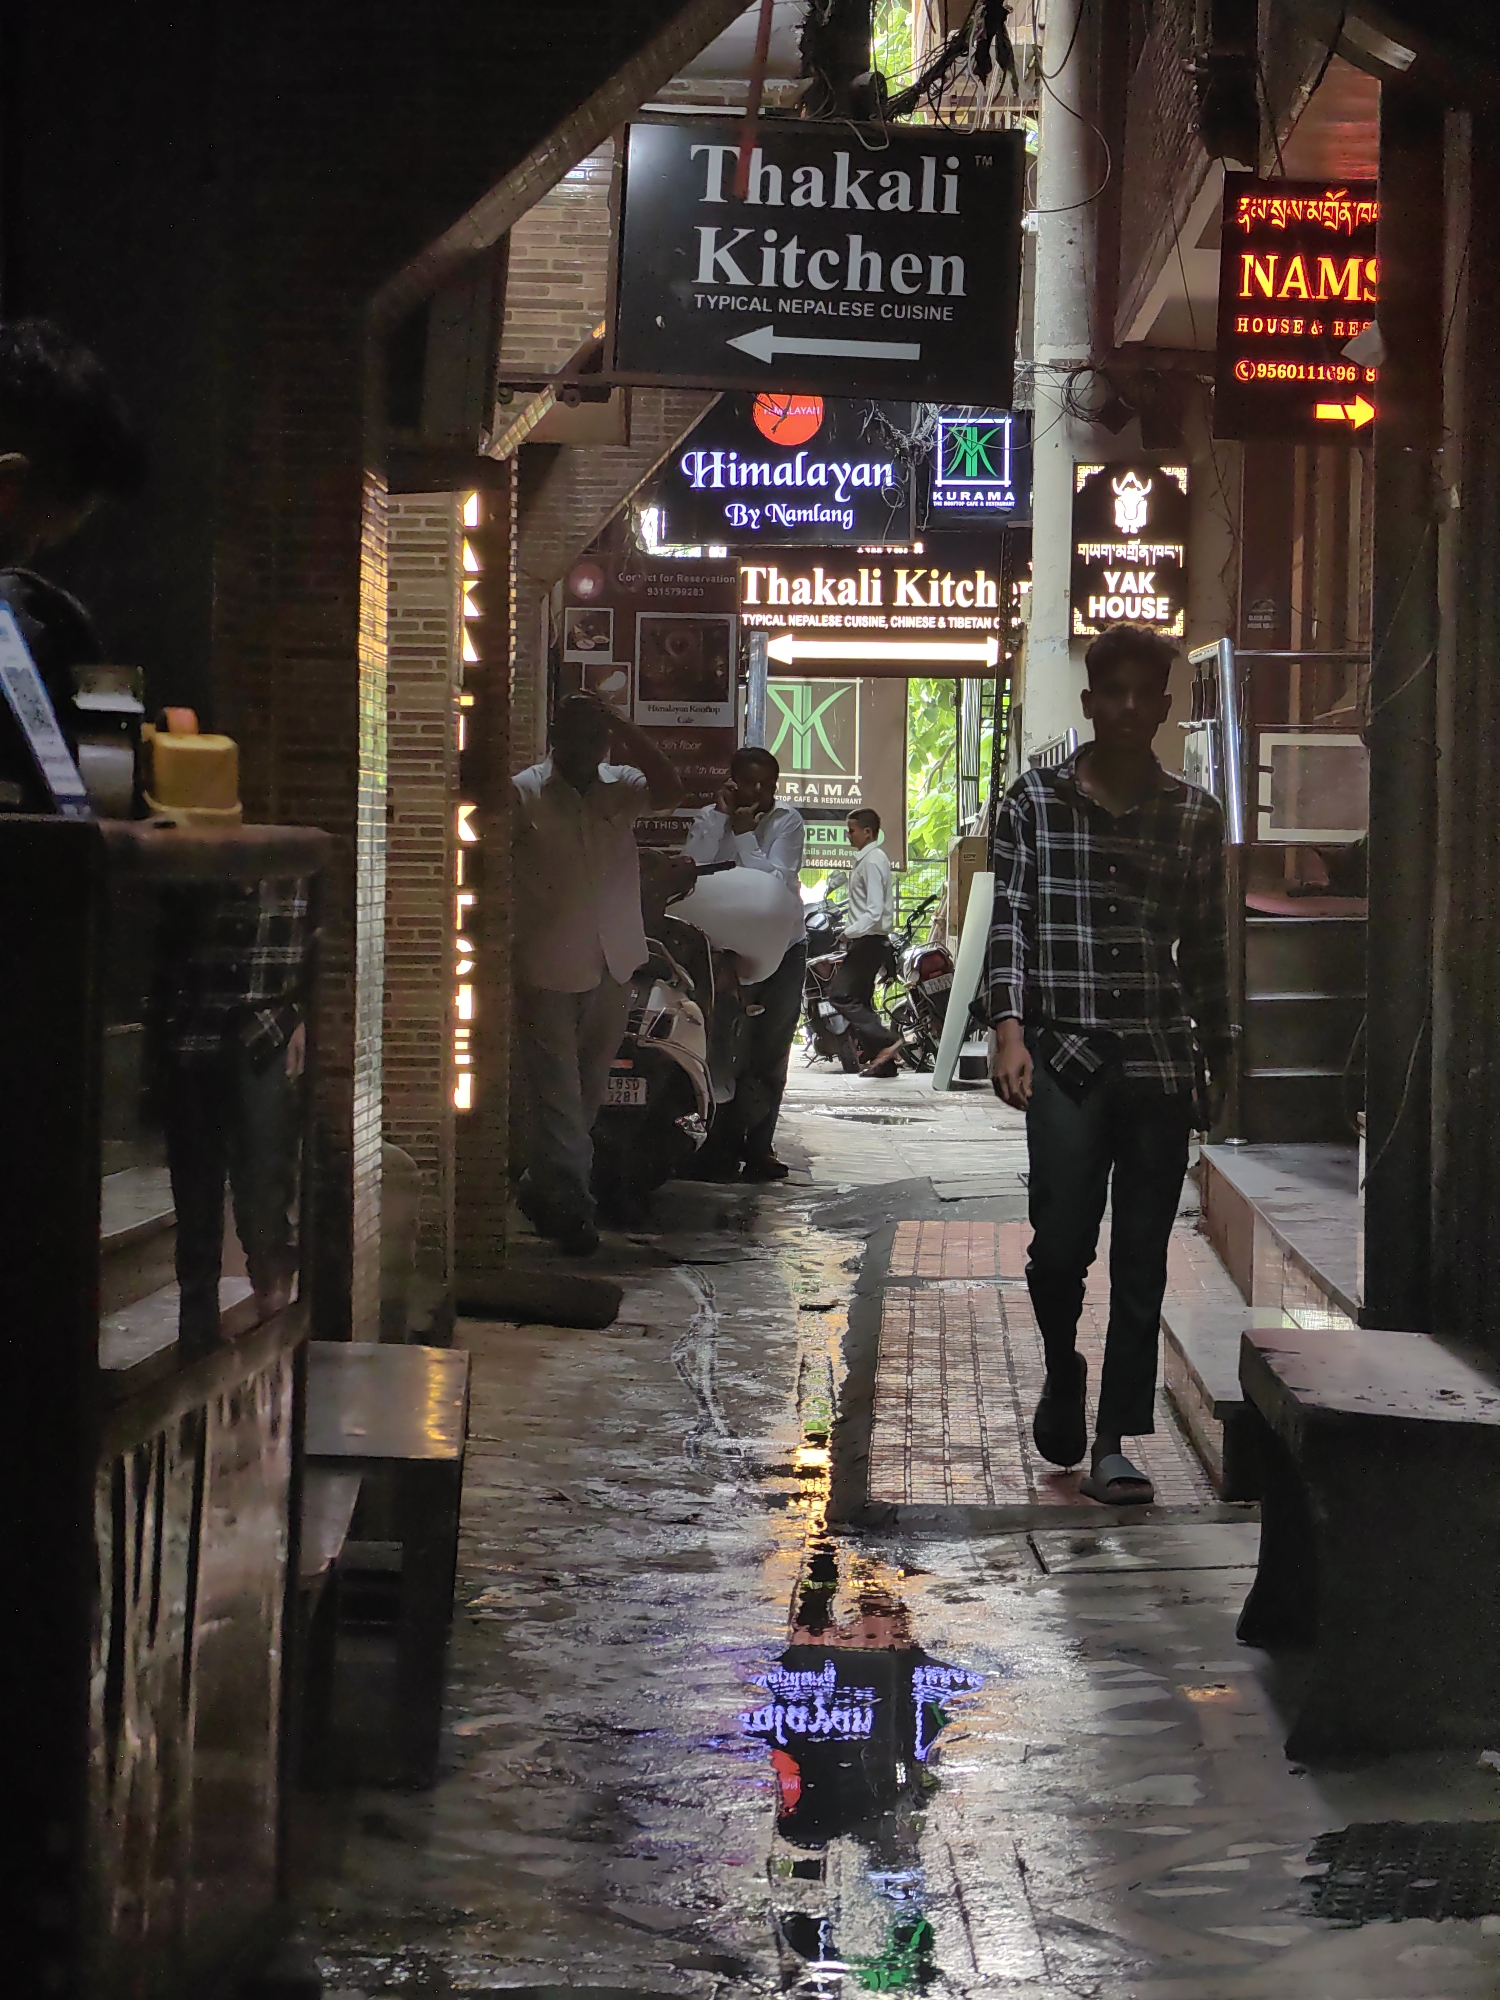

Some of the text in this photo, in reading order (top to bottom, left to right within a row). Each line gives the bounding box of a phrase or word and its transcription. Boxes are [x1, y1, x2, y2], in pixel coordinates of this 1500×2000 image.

[974, 155, 993, 167] TM
[690, 145, 961, 215] Thakali
[691, 226, 967, 297] Kitchen
[694, 294, 954, 321] TYPICAL NEPALESE CUISINE
[1237, 317, 1304, 334] HOUSE
[681, 451, 895, 502] Himalayan
[932, 490, 1016, 501] KURAMA
[724, 503, 854, 530] By Namlang
[659, 572, 674, 583] for
[676, 573, 736, 584] Reservation
[740, 566, 884, 607] Thakali
[1103, 571, 1156, 594] YAK
[1088, 596, 1170, 619] HOUSE
[742, 613, 787, 627] TYPICAL
[788, 614, 843, 627] NEPALESE
[844, 615, 889, 630] CUISINE,
[890, 616, 937, 629] CHINESE
[937, 617, 946, 629] &
[947, 617, 992, 630] TIBETAN
[709, 765, 730, 775] floor
[776, 782, 862, 796] RAMA
[653, 820, 679, 830] THIS
[803, 827, 838, 842] PEN
[822, 848, 837, 856] and
